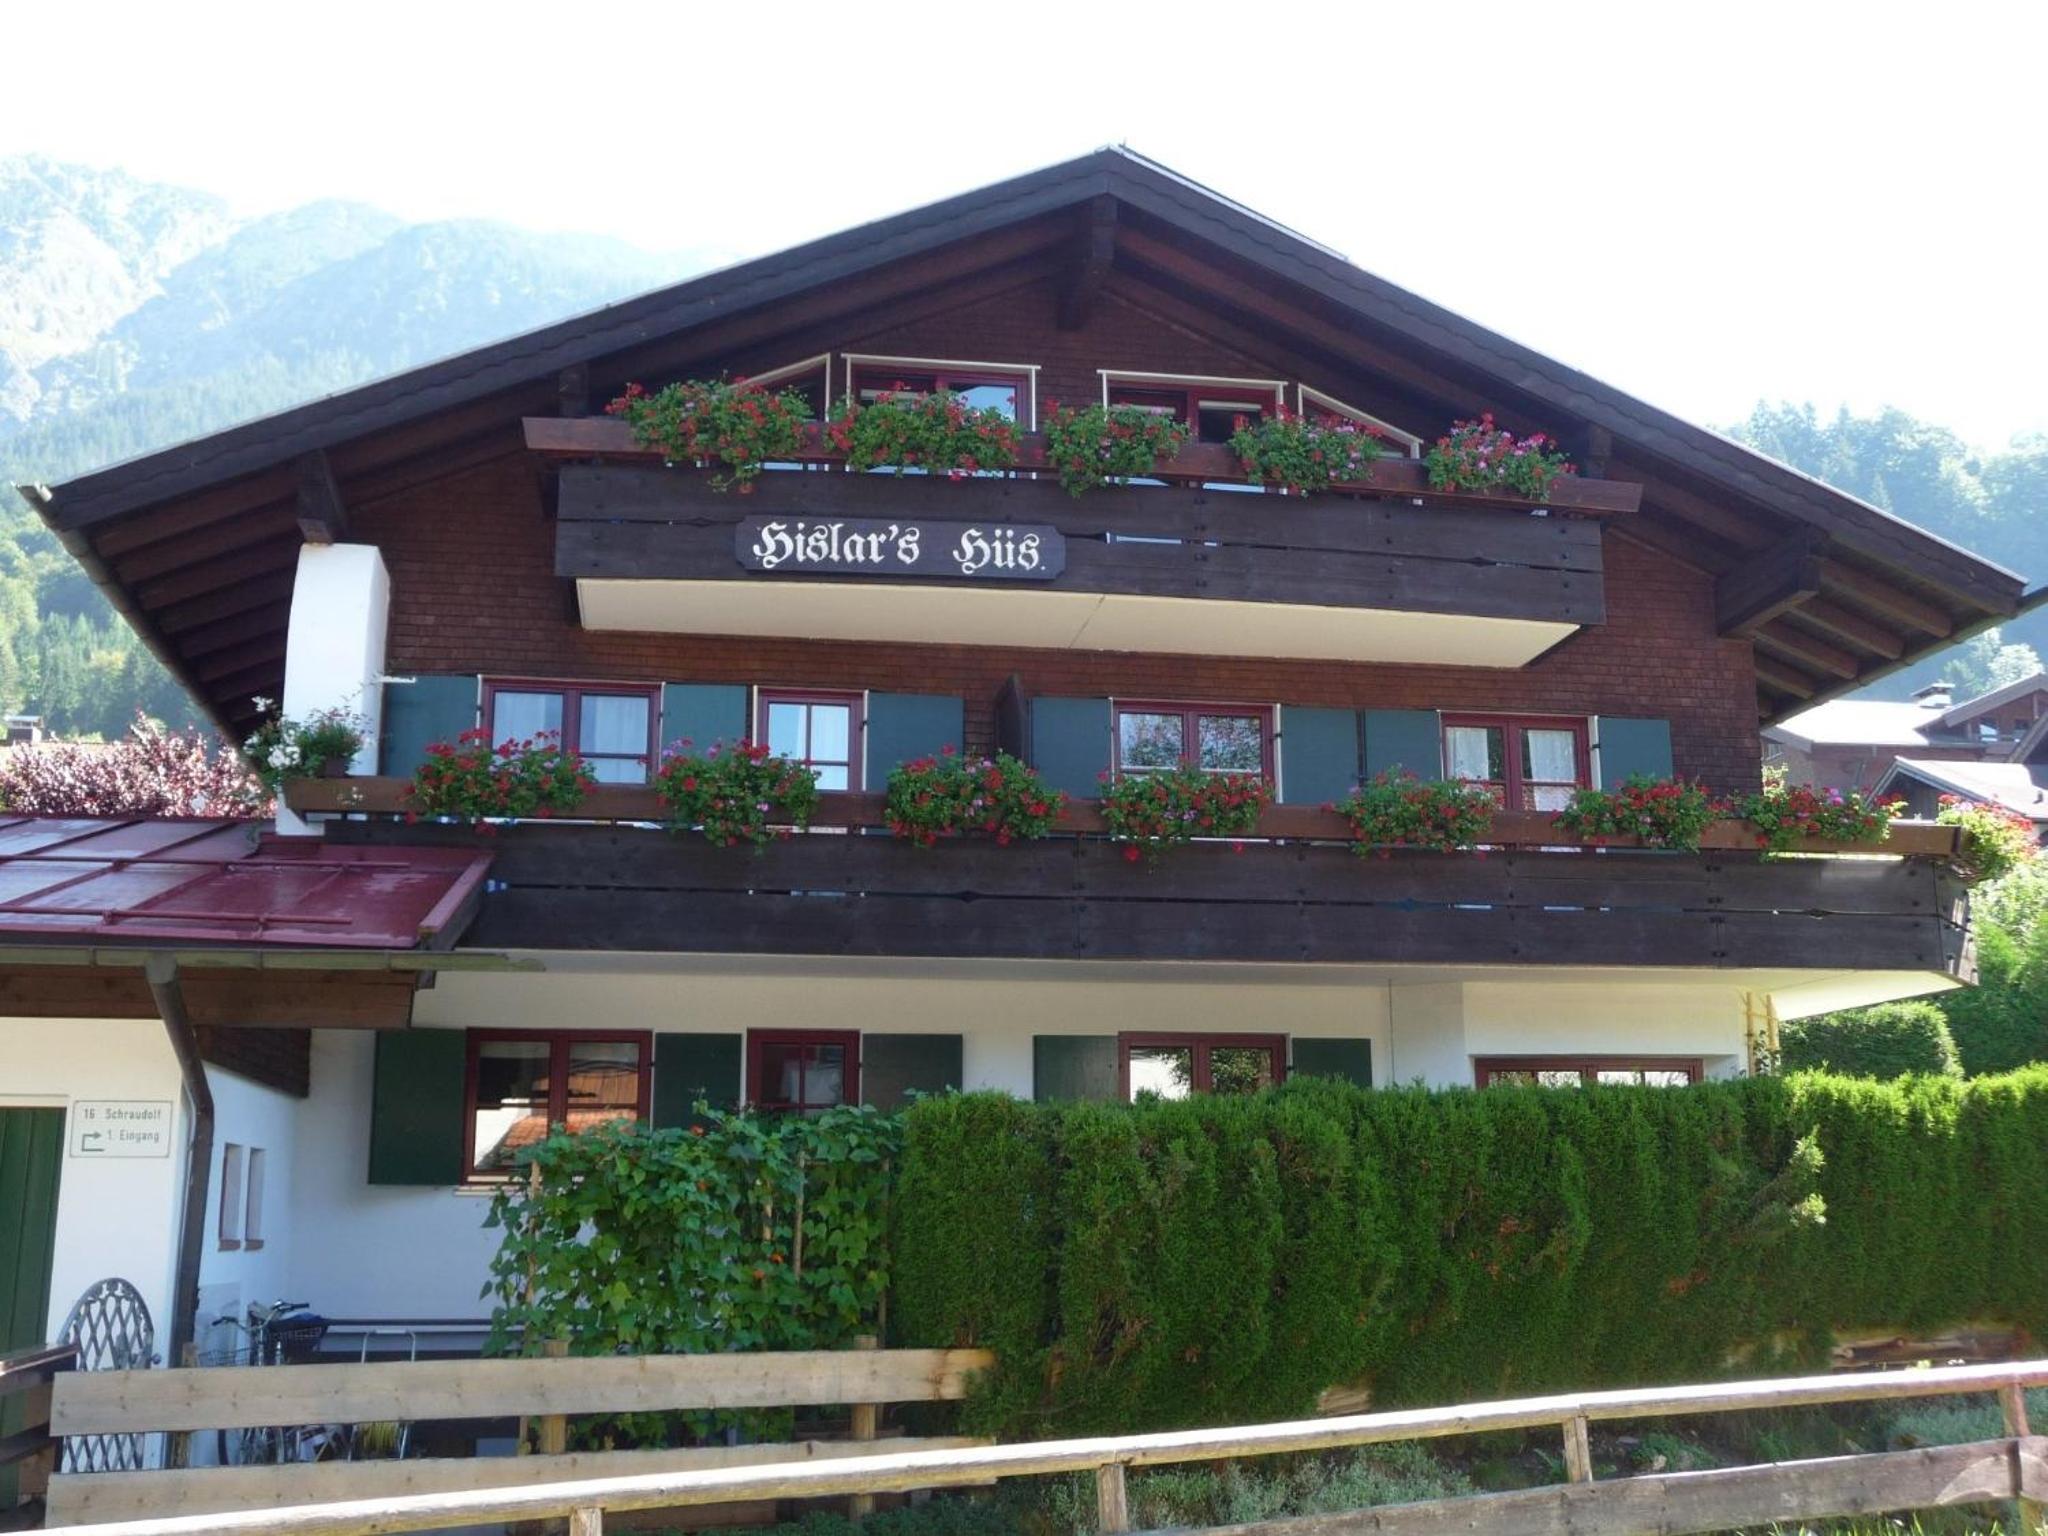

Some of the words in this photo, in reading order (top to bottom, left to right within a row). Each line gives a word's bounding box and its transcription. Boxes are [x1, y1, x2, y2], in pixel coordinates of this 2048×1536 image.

[753, 521, 920, 569] Hislar's
[84, 1108, 95, 1119] 16
[119, 1129, 159, 1143] Eingang
